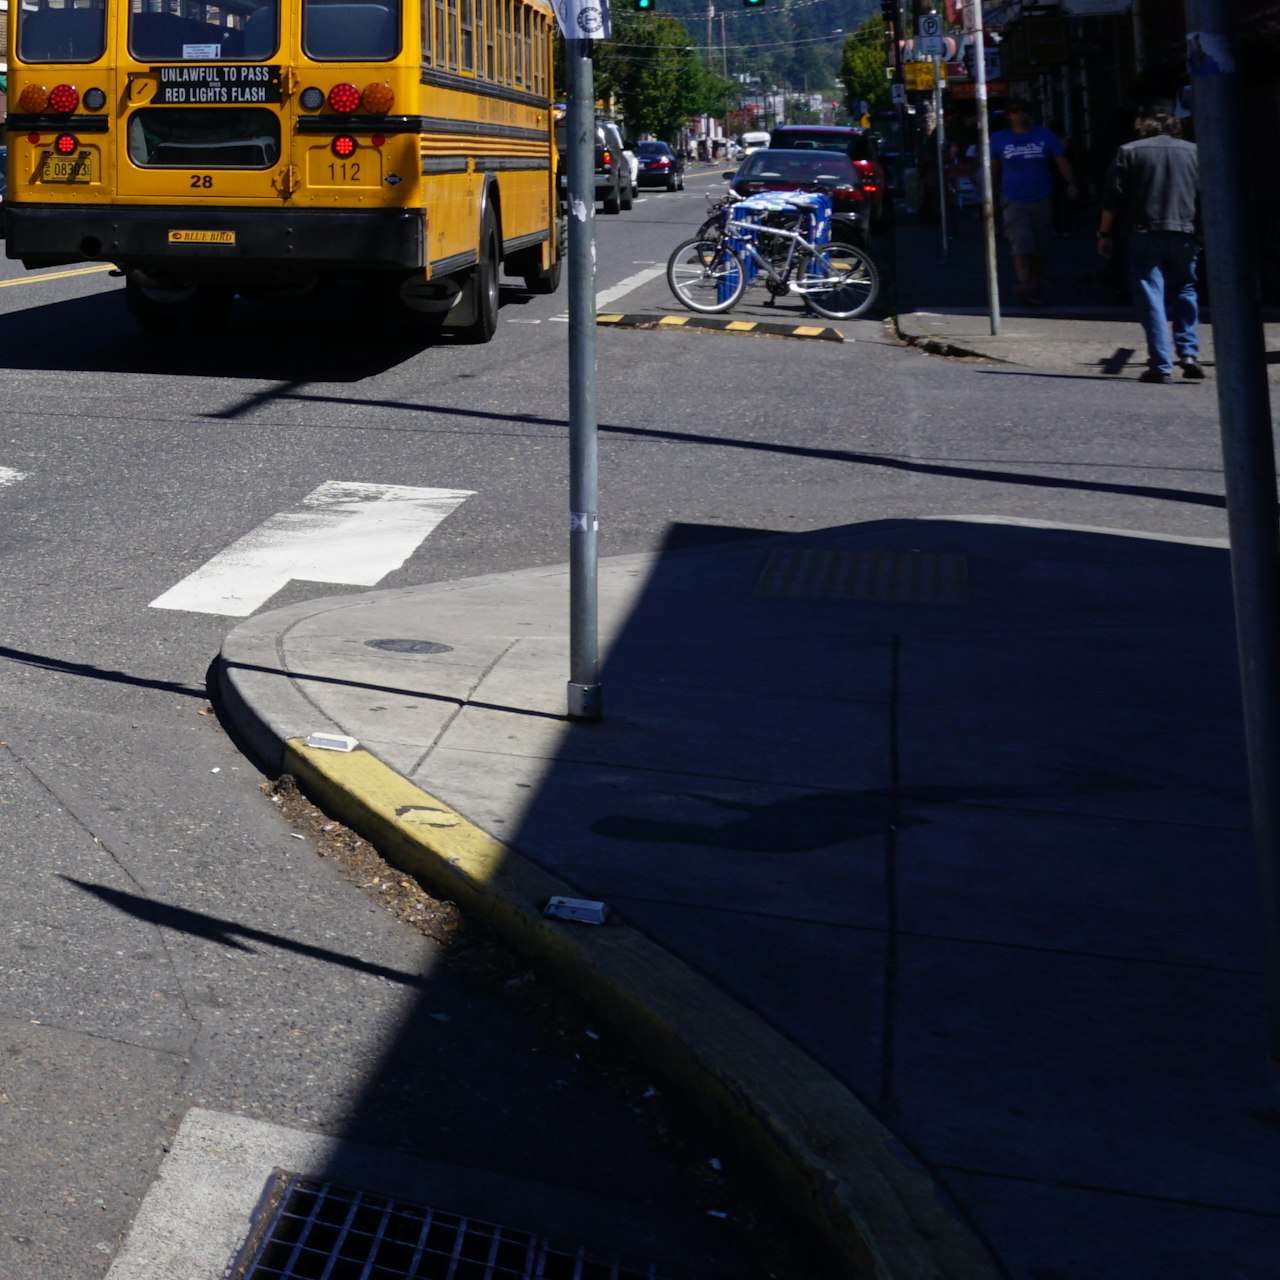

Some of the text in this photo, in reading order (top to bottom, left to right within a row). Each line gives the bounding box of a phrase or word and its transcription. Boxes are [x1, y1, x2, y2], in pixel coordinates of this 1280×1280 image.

[161, 67, 269, 81] UNLAWFUL TO PASS
[165, 87, 266, 102] RED LIGHTS FLASH
[328, 163, 361, 181] 112
[190, 175, 213, 188] 28
[184, 232, 233, 242] BLUE BIRD
